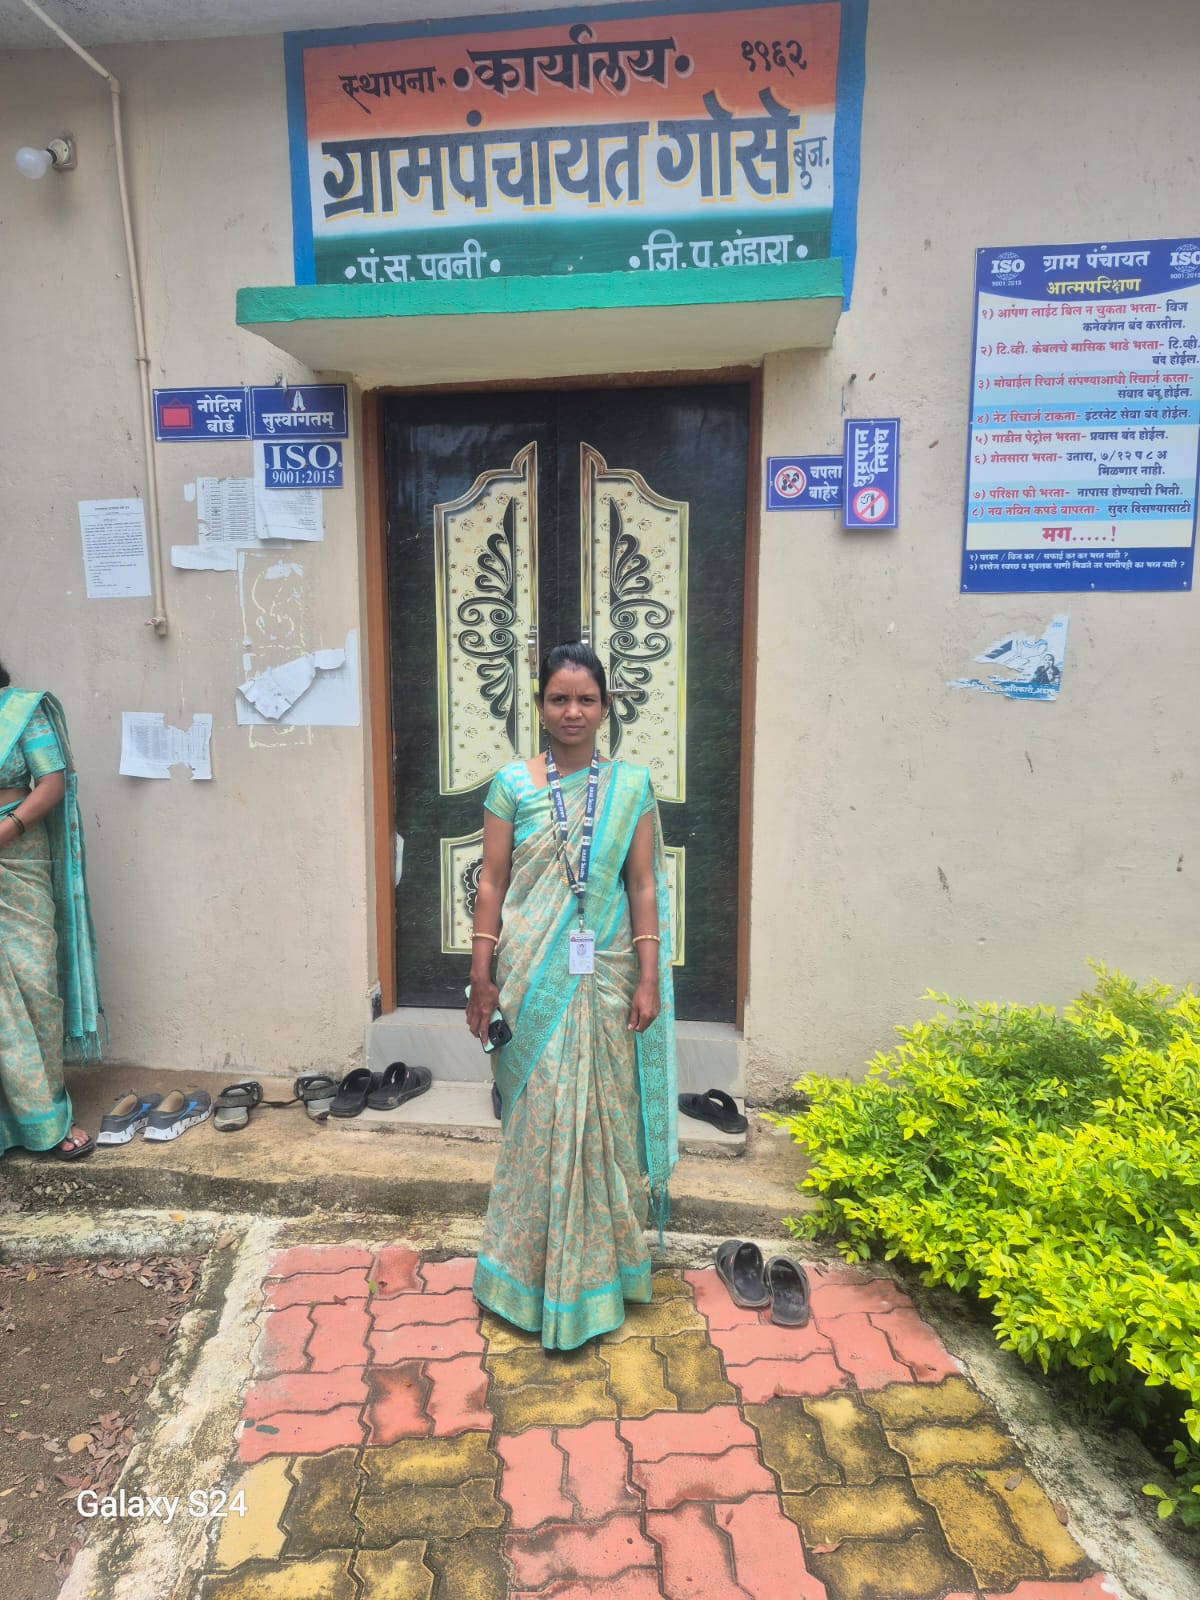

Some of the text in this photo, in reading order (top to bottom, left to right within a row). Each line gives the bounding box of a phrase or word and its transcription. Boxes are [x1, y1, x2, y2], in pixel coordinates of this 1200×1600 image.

[466, 23, 677, 97] कार्यालय
[741, 39, 808, 77] १९६२
[321, 109, 654, 222] ग्रामपंचायत
[656, 86, 806, 204] गोसे
[721, 228, 794, 267] भंडारा
[416, 239, 488, 281] पवनी
[991, 258, 1025, 274] ISO
[1042, 248, 1151, 272] ग्राम पंचायत
[1031, 303, 1058, 318] लाईट
[1061, 303, 1083, 316] बिल
[1085, 305, 1093, 315] न
[1096, 304, 1128, 319] चुकता
[1166, 299, 1189, 312] विज
[1128, 317, 1143, 330] बंद
[1152, 352, 1167, 365] बंद
[1034, 372, 1065, 387] रिचार्ज
[1129, 370, 1160, 385] रिचार्ज
[1147, 385, 1162, 398] बंद
[196, 394, 242, 413] नोटिस
[261, 411, 335, 434] सुस्वागतम्
[993, 410, 1007, 423] नेट
[1010, 408, 1042, 423] रिचार्ज
[1120, 406, 1141, 420] सेवा
[1144, 406, 1159, 419] बंद
[205, 415, 236, 433] बोर्ड
[991, 429, 1022, 443] गाडीत
[1090, 431, 1118, 441] प्रवास
[1121, 427, 1136, 441] बंद
[268, 444, 338, 471] ISO
[1145, 451, 1153, 460] ८
[1156, 449, 1168, 460] अ
[271, 470, 336, 485] 9001:2015
[808, 481, 840, 502] बाहेर
[1022, 485, 1036, 499] फी
[1077, 487, 1110, 497] नापास
[1033, 503, 1058, 516] कपडे
